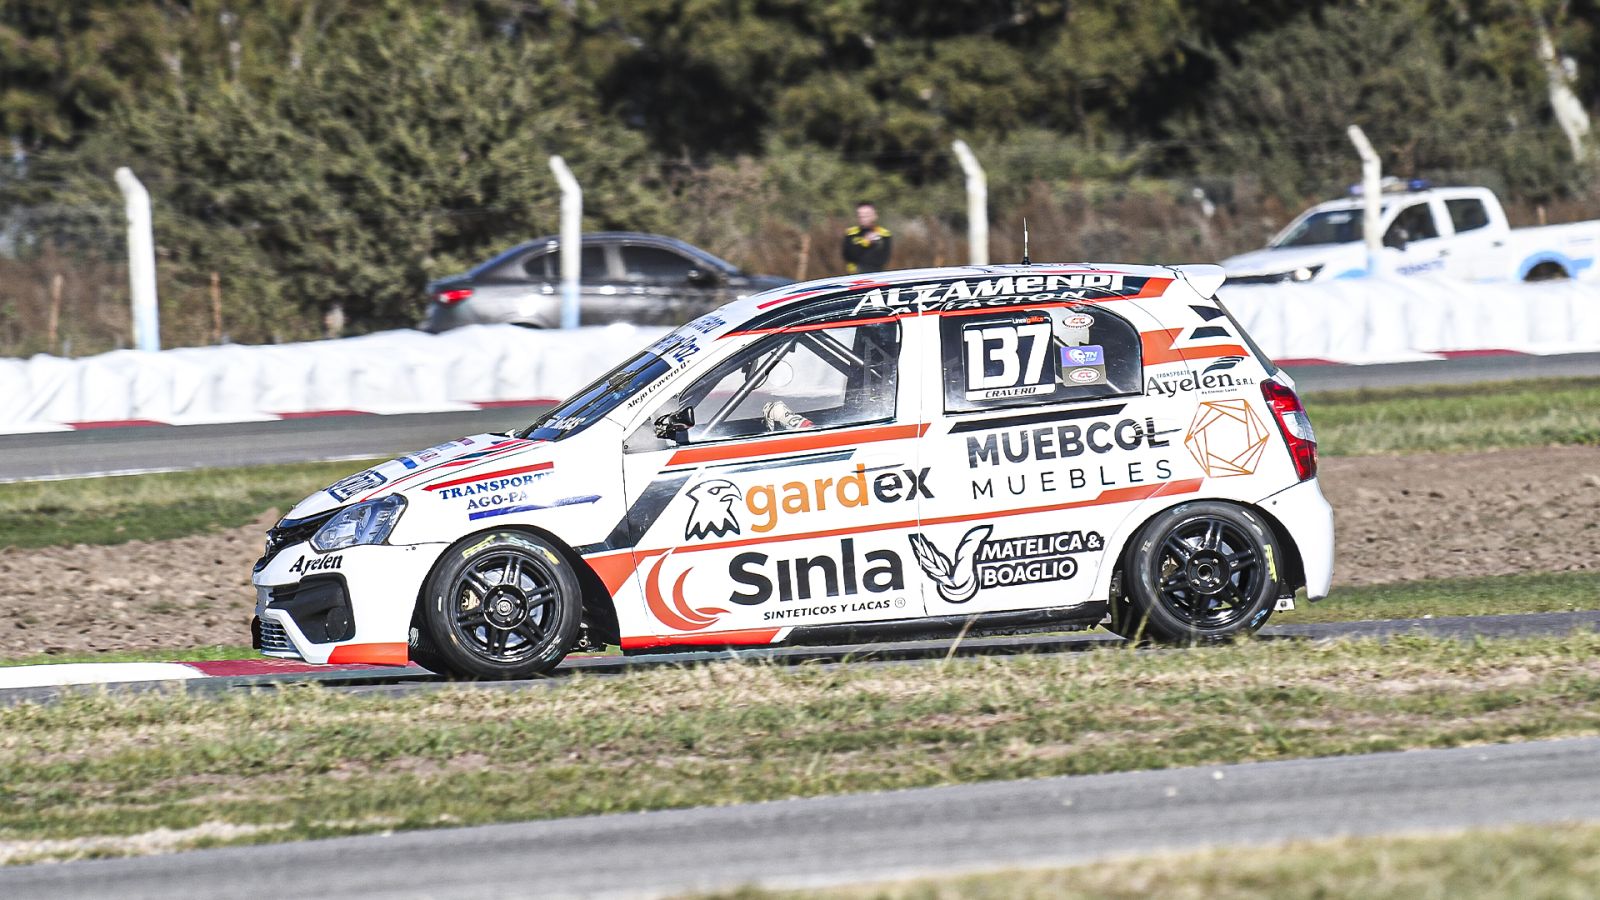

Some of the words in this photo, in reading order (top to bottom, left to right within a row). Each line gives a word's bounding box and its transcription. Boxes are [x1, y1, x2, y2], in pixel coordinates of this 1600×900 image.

[963, 323, 1052, 390] 137
[627, 391, 648, 411] Alejo
[648, 367, 679, 393] Cravero
[985, 387, 1037, 398] CRAVERO
[1236, 377, 1257, 386] S.R.L.
[966, 416, 1170, 469] MUEBCOL
[439, 470, 555, 500] TRANSPORT
[972, 459, 1172, 500] MUEBLES
[745, 463, 935, 533] gardex
[980, 532, 1083, 561] MATELICA
[1086, 534, 1101, 549] &
[288, 553, 344, 575] Ayelen
[983, 559, 1075, 587] BOAGLIO
[763, 605, 837, 621] SINTETICOS
[841, 604, 848, 613] Y
[851, 599, 891, 613] LACAS
